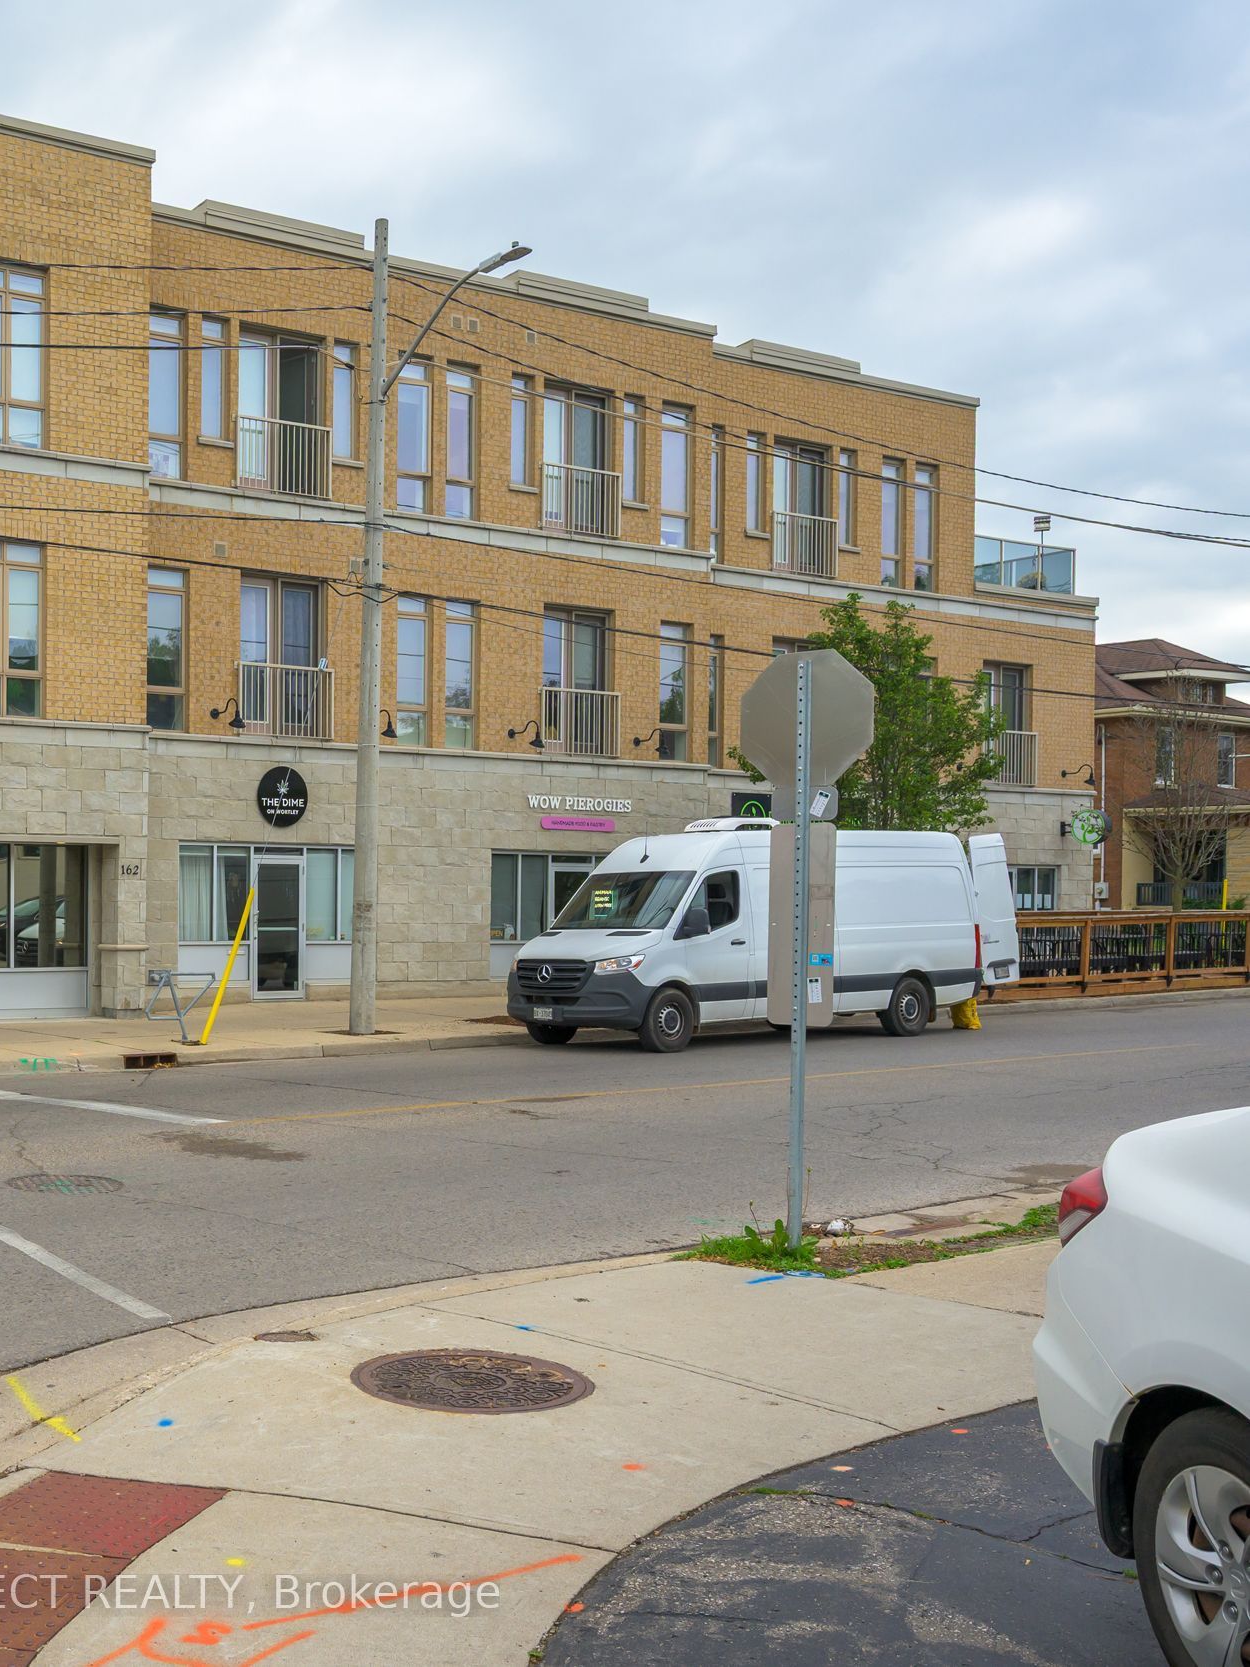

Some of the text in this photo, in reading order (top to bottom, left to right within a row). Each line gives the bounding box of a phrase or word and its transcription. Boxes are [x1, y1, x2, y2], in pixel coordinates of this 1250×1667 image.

[261, 797, 305, 807] THE DIME
[527, 794, 632, 812] WOW PIEROGIES
[121, 864, 139, 875] 162
